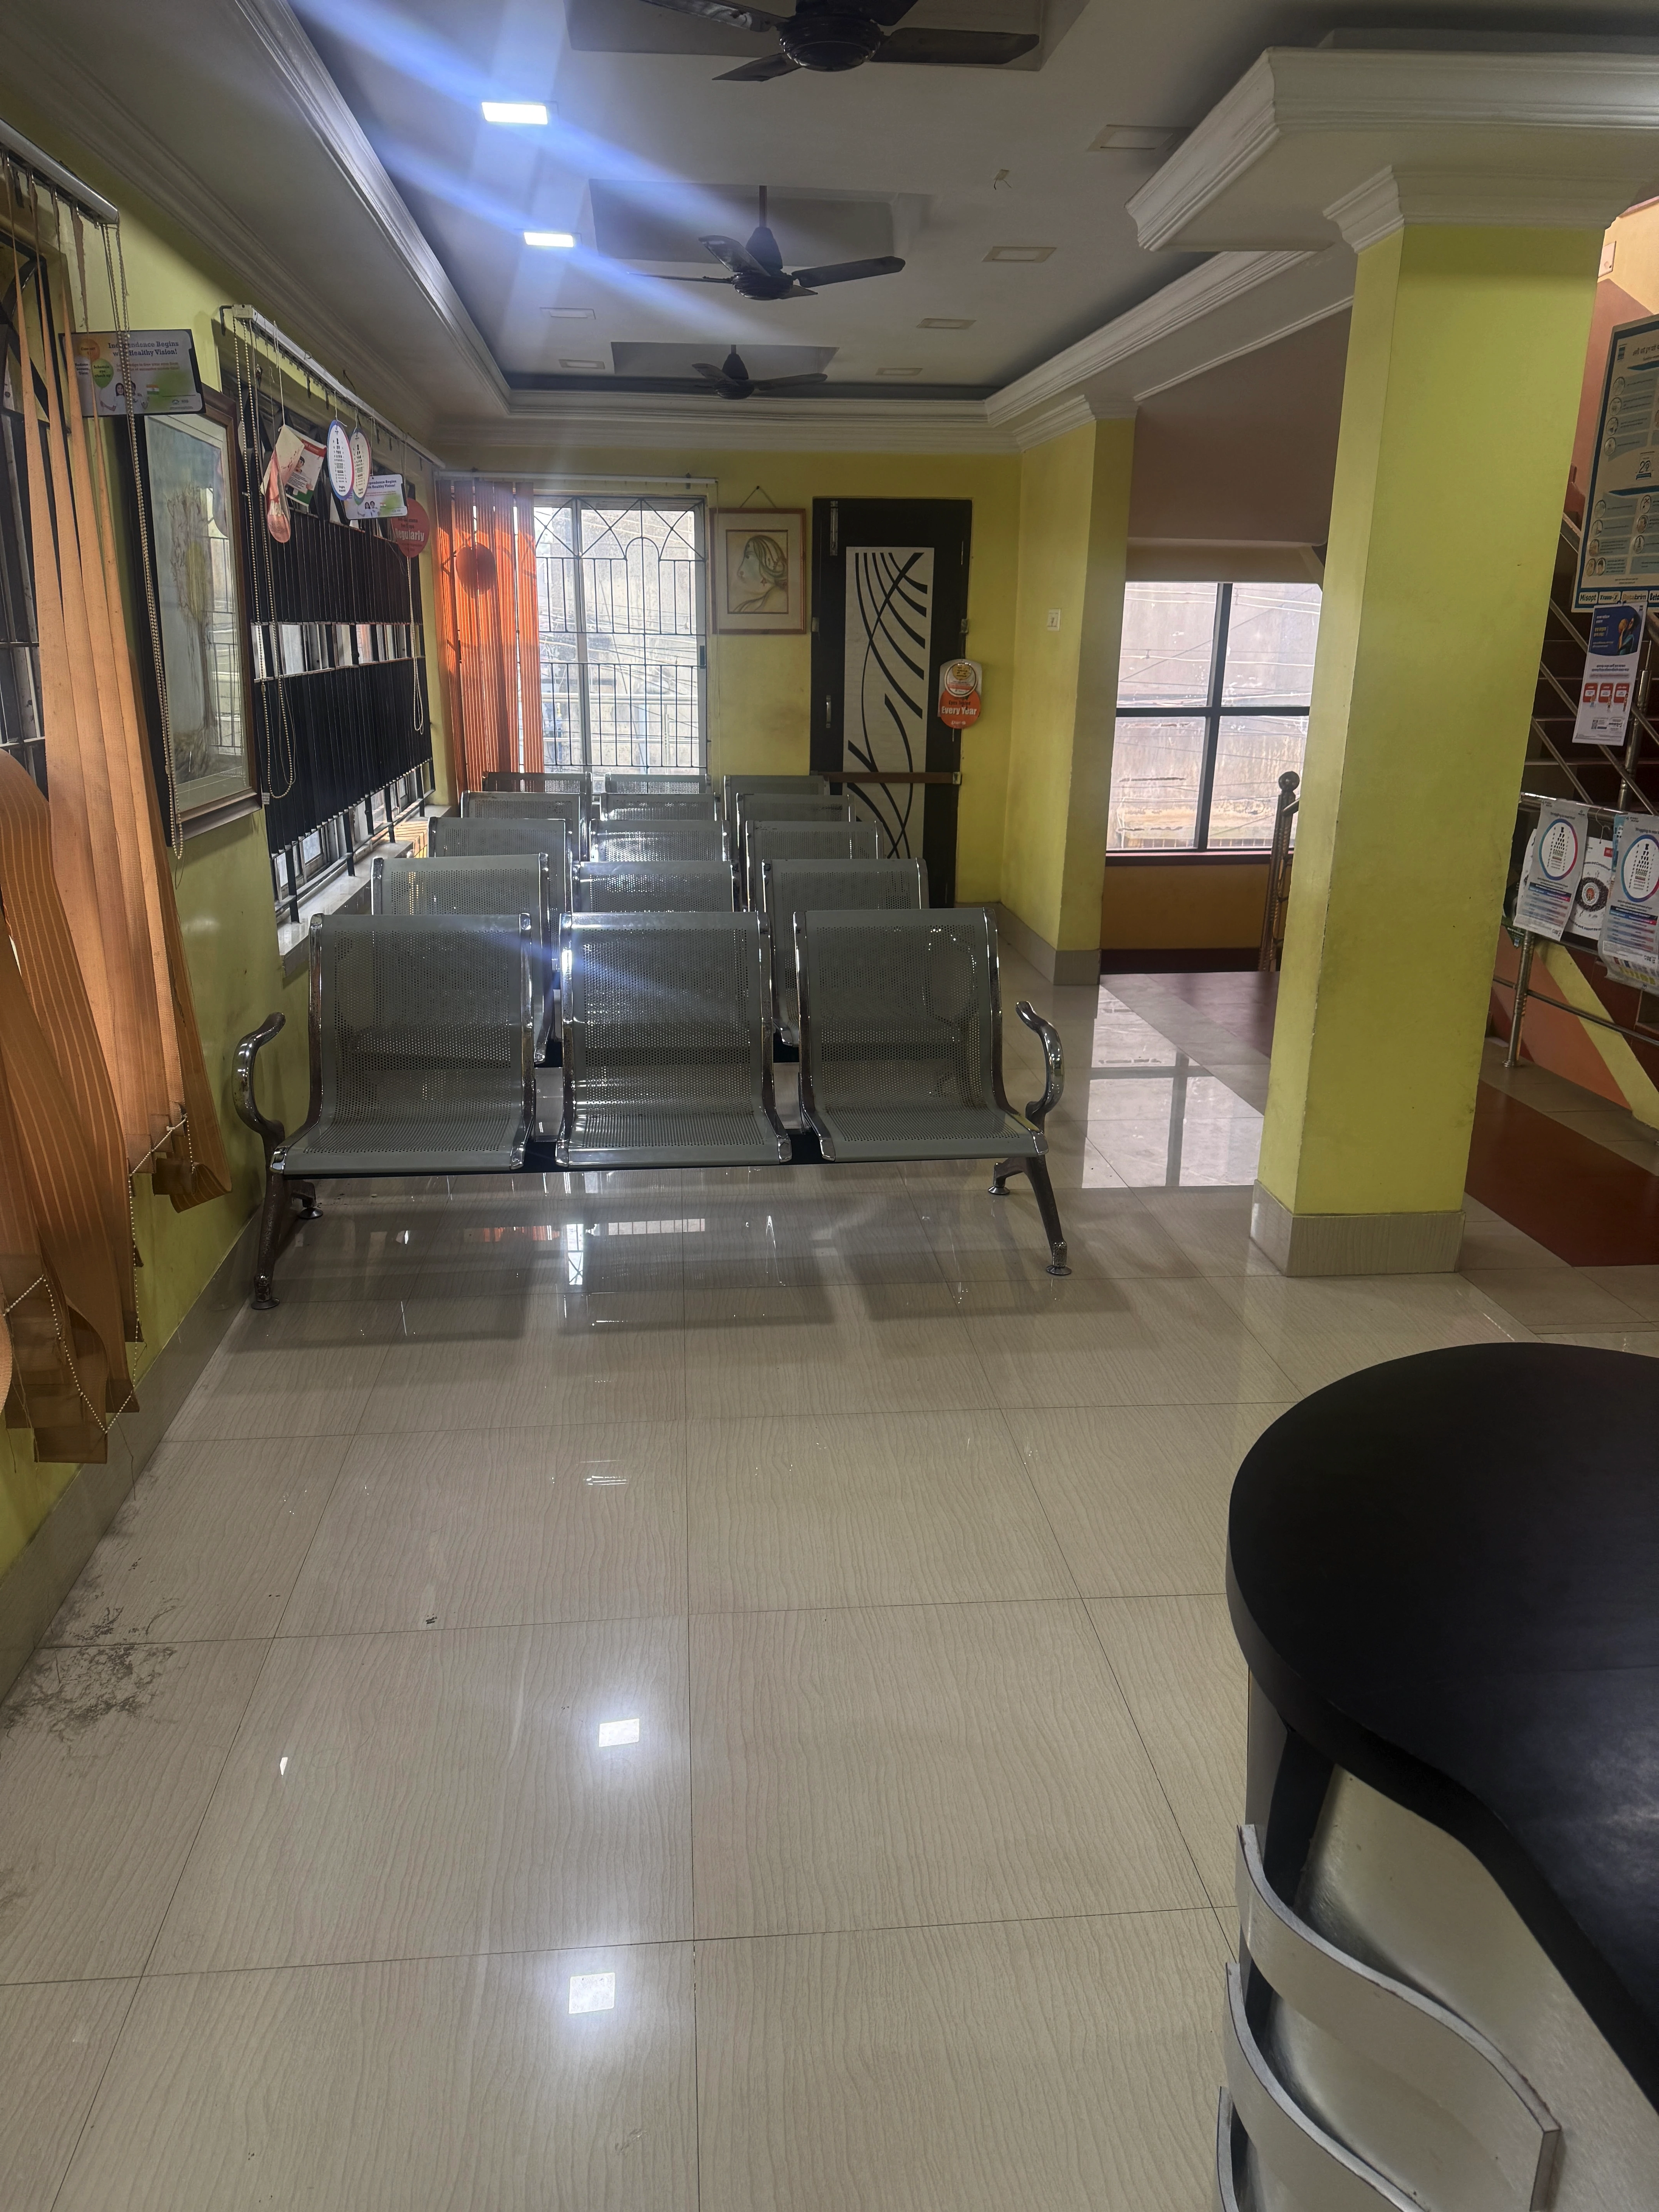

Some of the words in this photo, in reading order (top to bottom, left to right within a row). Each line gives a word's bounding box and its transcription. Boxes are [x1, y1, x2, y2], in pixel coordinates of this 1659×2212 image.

[395, 528, 424, 542] Regularly
[1580, 594, 1596, 602] Misopt
[941, 706, 960, 715] Every
[961, 706, 977, 715] Year
